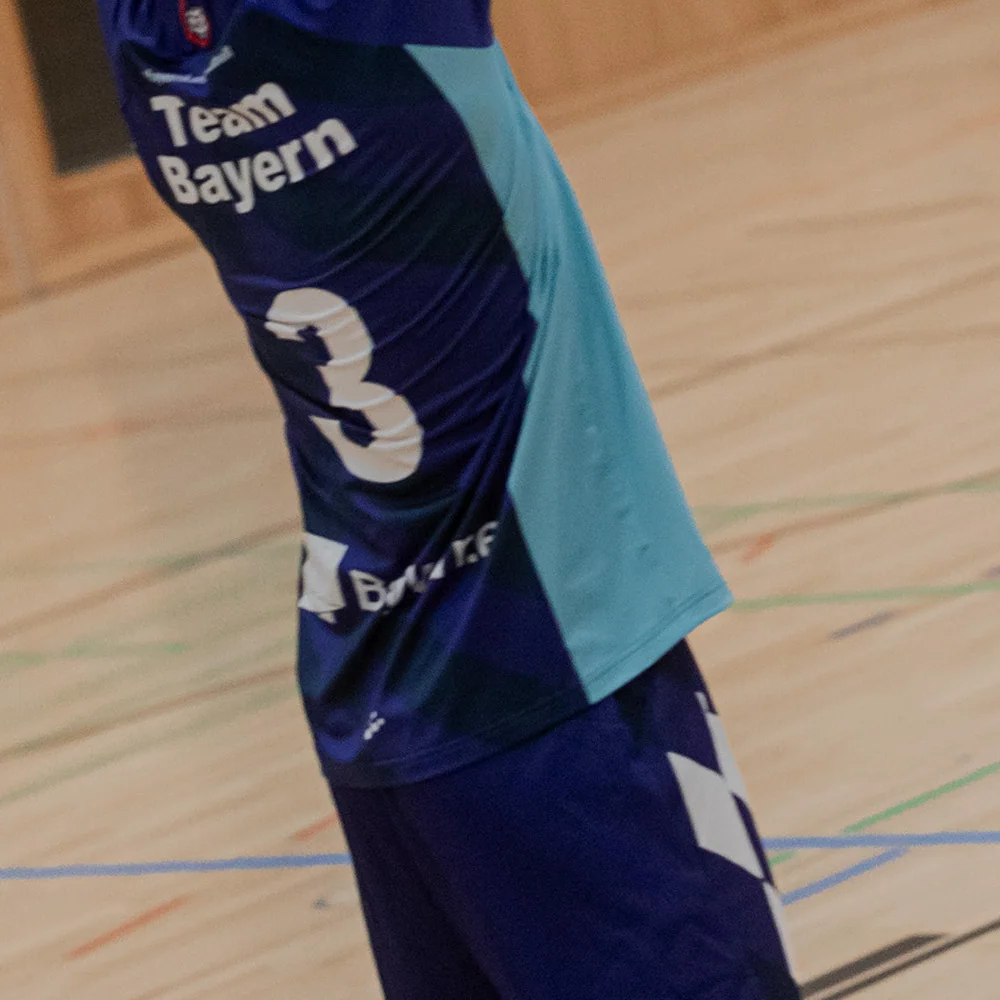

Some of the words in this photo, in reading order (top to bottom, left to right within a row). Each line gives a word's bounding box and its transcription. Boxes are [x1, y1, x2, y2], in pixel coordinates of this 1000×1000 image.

[150, 82, 297, 148] Team
[157, 117, 359, 214] Bayern
[265, 287, 425, 484] 3
